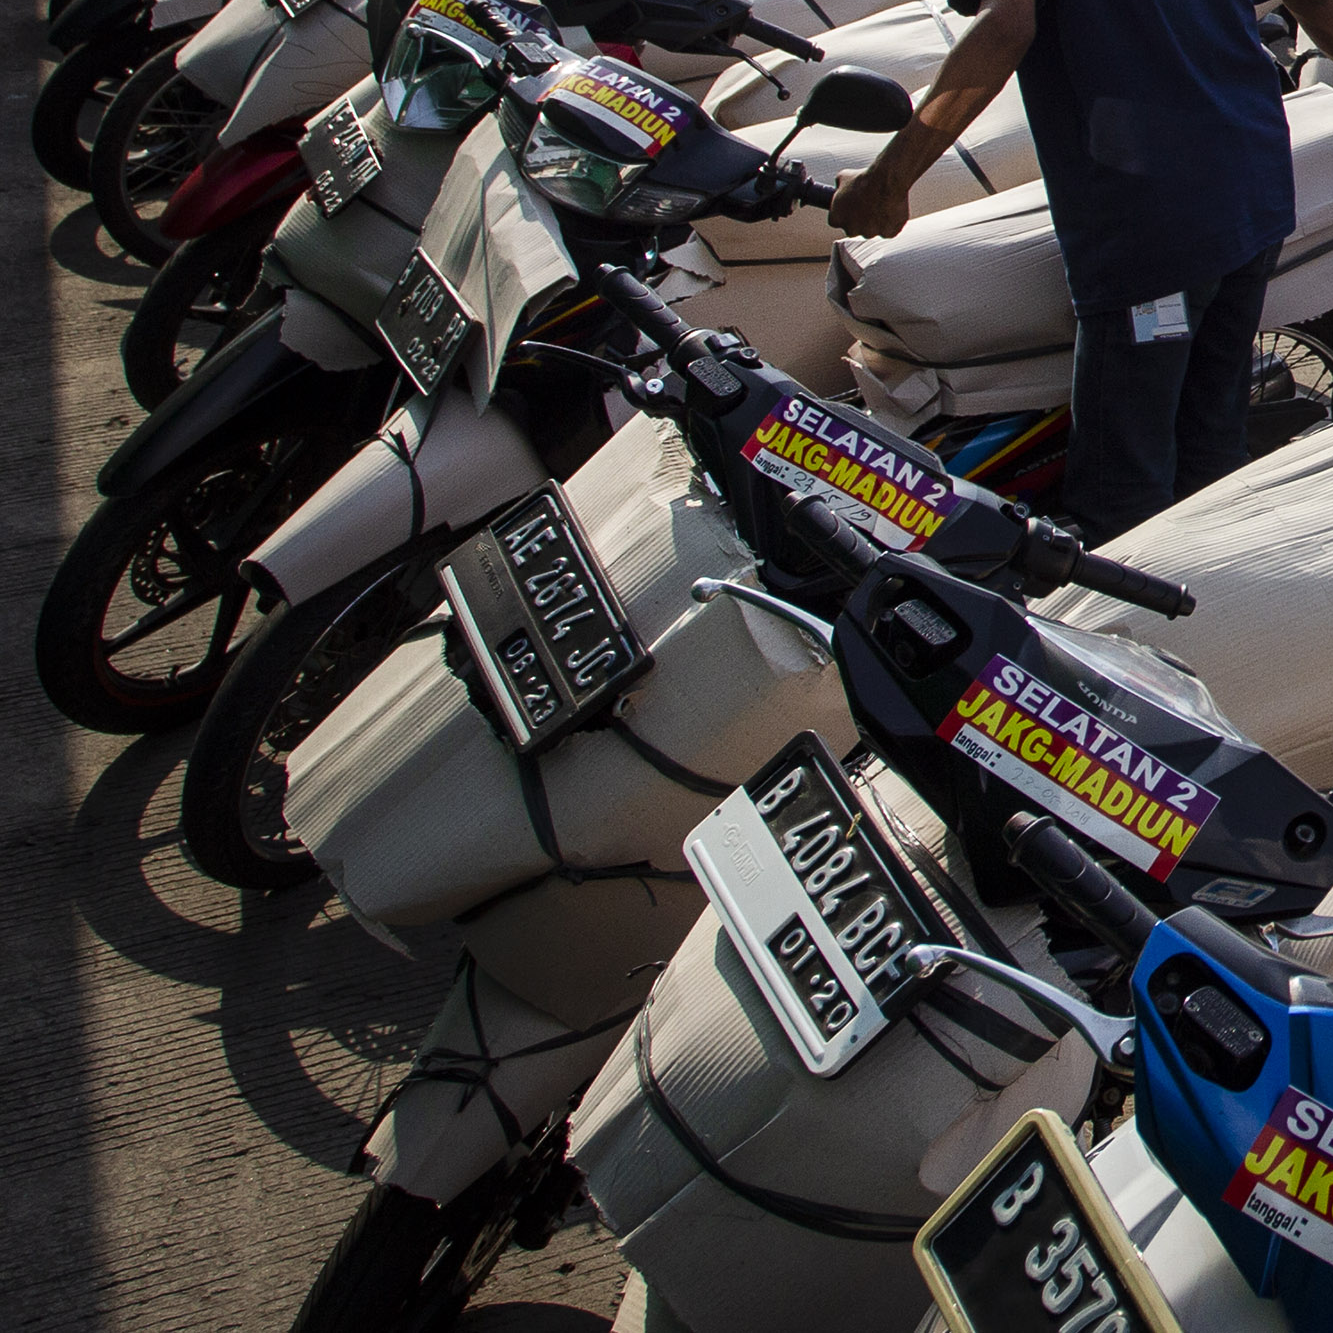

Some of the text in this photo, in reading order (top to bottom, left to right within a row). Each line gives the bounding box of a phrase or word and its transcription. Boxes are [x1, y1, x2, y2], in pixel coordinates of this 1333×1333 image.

[663, 104, 684, 123] 2
[755, 421, 945, 538] JAKG-MADIUN
[783, 399, 947, 508] SELATAN 2
[478, 554, 506, 600] HONDA
[504, 512, 617, 687] AE 2674 JC
[992, 664, 1199, 813] SELATAN 2
[1076, 679, 1139, 726] HONDA
[754, 764, 805, 817] B
[955, 688, 1198, 858] JAKG-MADIUN
[779, 809, 872, 917] 4084
[991, 1160, 1045, 1227] B
